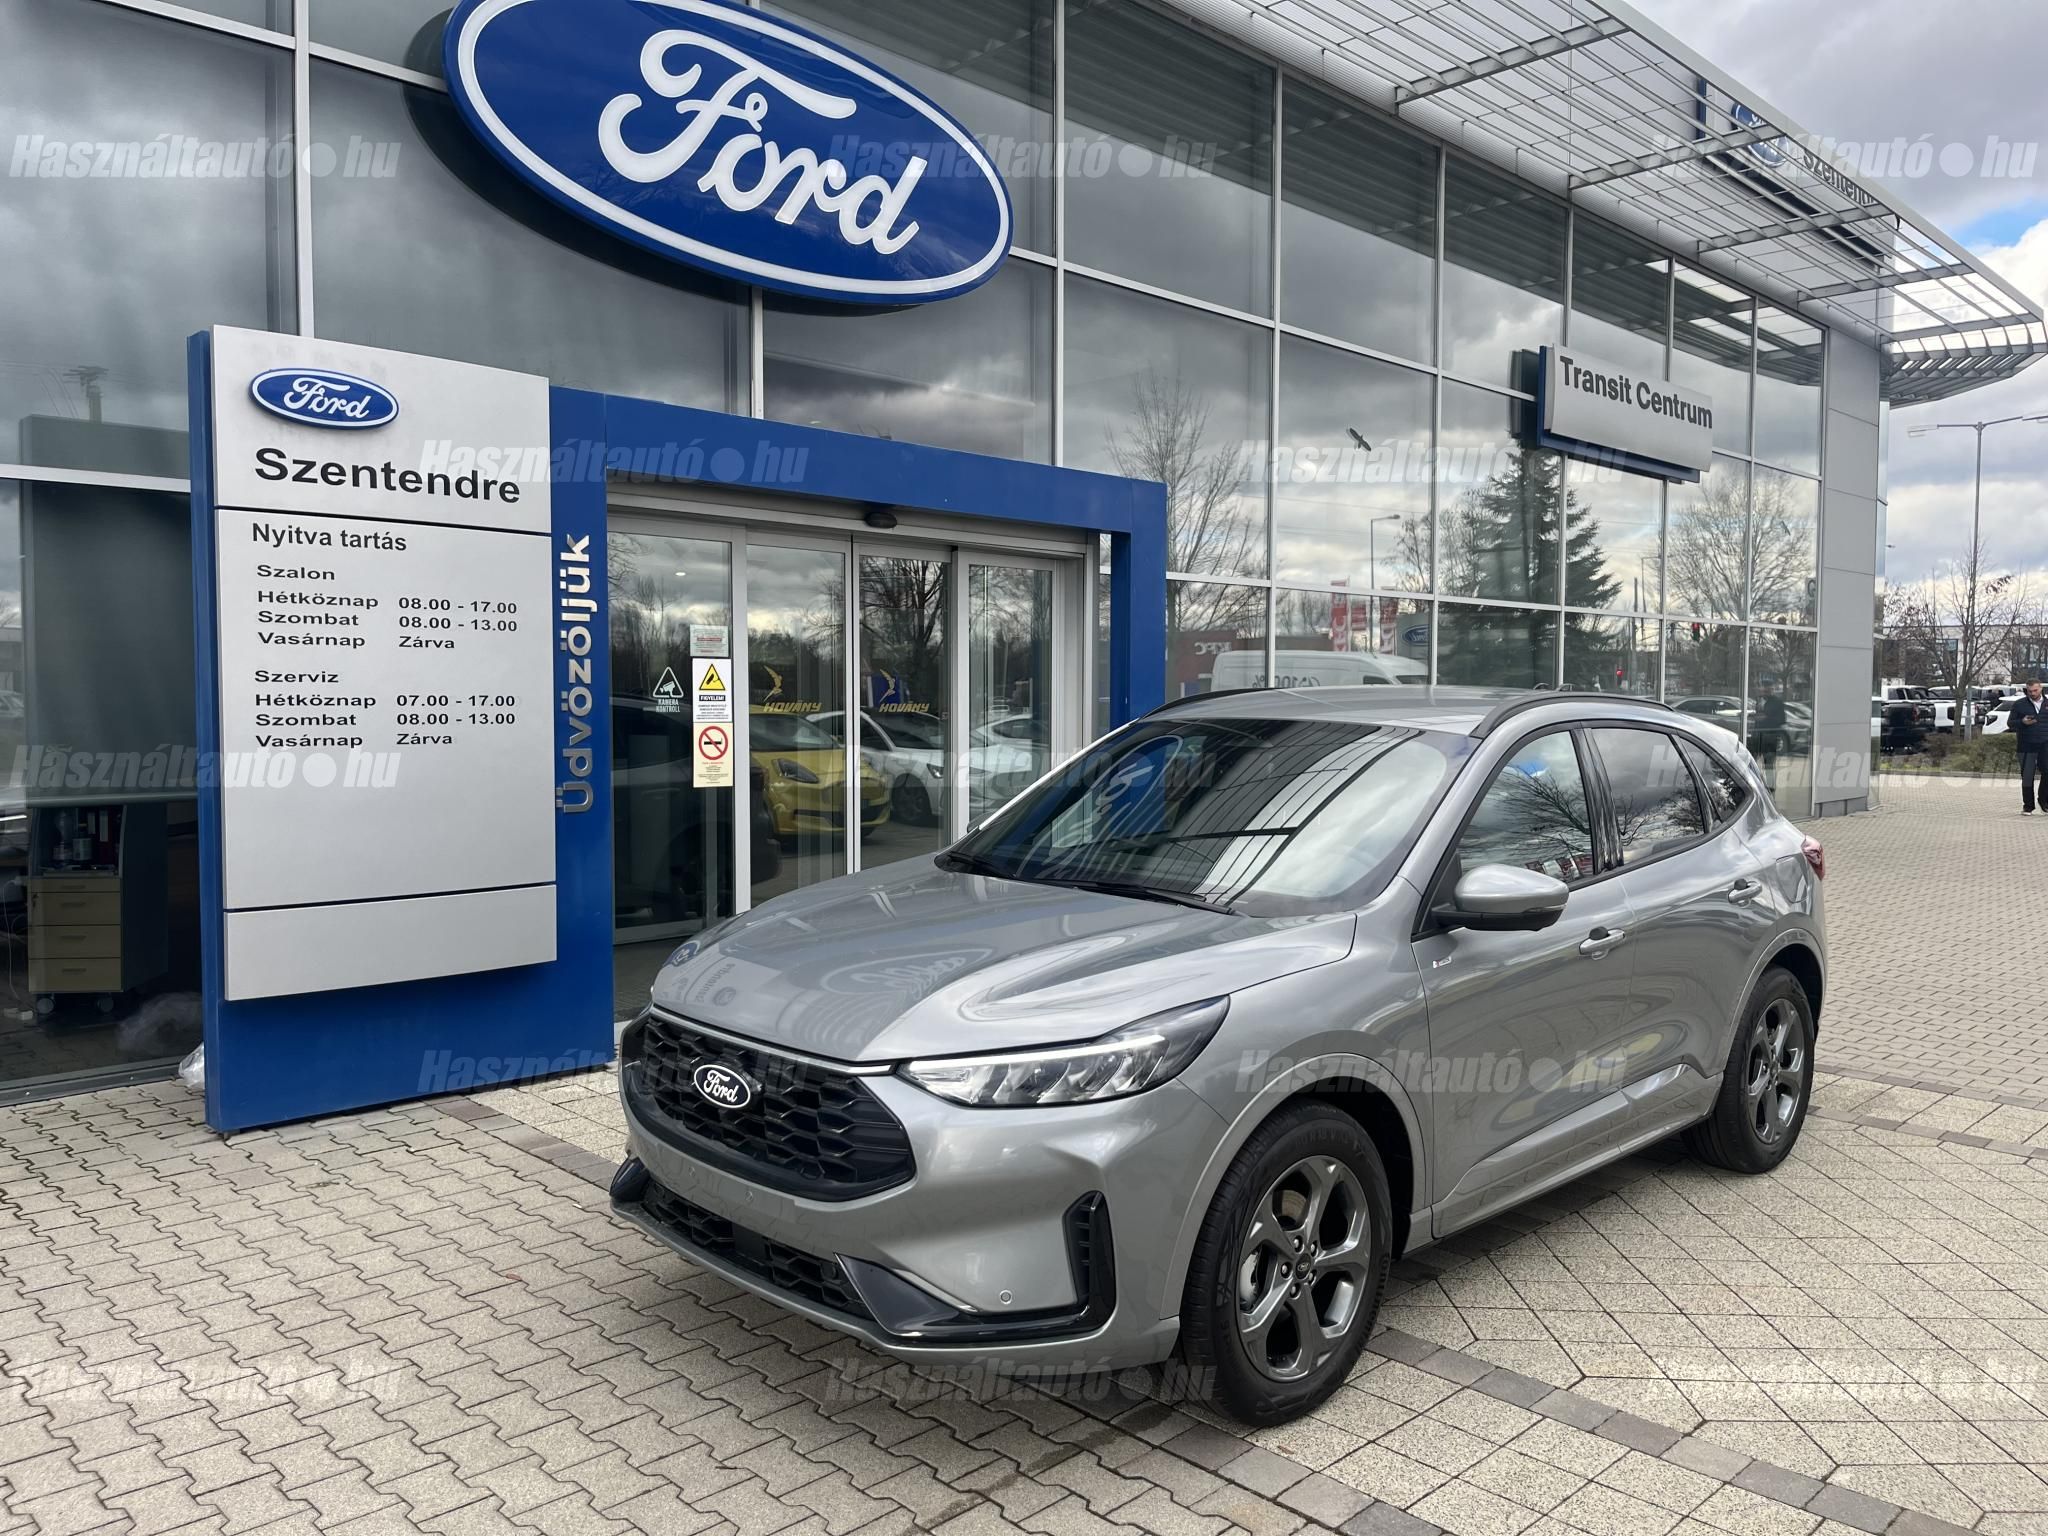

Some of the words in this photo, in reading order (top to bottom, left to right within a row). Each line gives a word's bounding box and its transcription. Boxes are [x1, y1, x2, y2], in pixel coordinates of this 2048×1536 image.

[598, 29, 928, 255] Ford
[283, 377, 372, 420] Ford
[1560, 355, 1632, 404] Transit
[1636, 381, 1713, 429] Centrum
[255, 447, 521, 504] Szentendre
[252, 522, 332, 547] Nyitva
[340, 529, 407, 551] tartás
[256, 565, 336, 581] Szalon
[257, 590, 379, 609] Hétköznap
[398, 597, 451, 611] 08.00
[470, 601, 517, 614] 17.00
[257, 610, 359, 626] Szombat
[398, 616, 451, 629] 08.00
[470, 619, 518, 632] 13.00
[257, 631, 366, 649] Vasárnap
[398, 636, 455, 649] Zárva
[254, 669, 339, 683] Szerviz
[555, 534, 598, 813] Üdvözöljük
[255, 693, 377, 709] Hétköznap
[396, 695, 449, 707] 07.00
[468, 695, 515, 707] 17.00
[255, 713, 357, 727] Szombat
[396, 713, 449, 726] 08.00
[468, 713, 515, 725] 13.00
[255, 734, 363, 749] Vasárnap
[396, 733, 453, 745] Zárva
[703, 1069, 740, 1103] Ford
